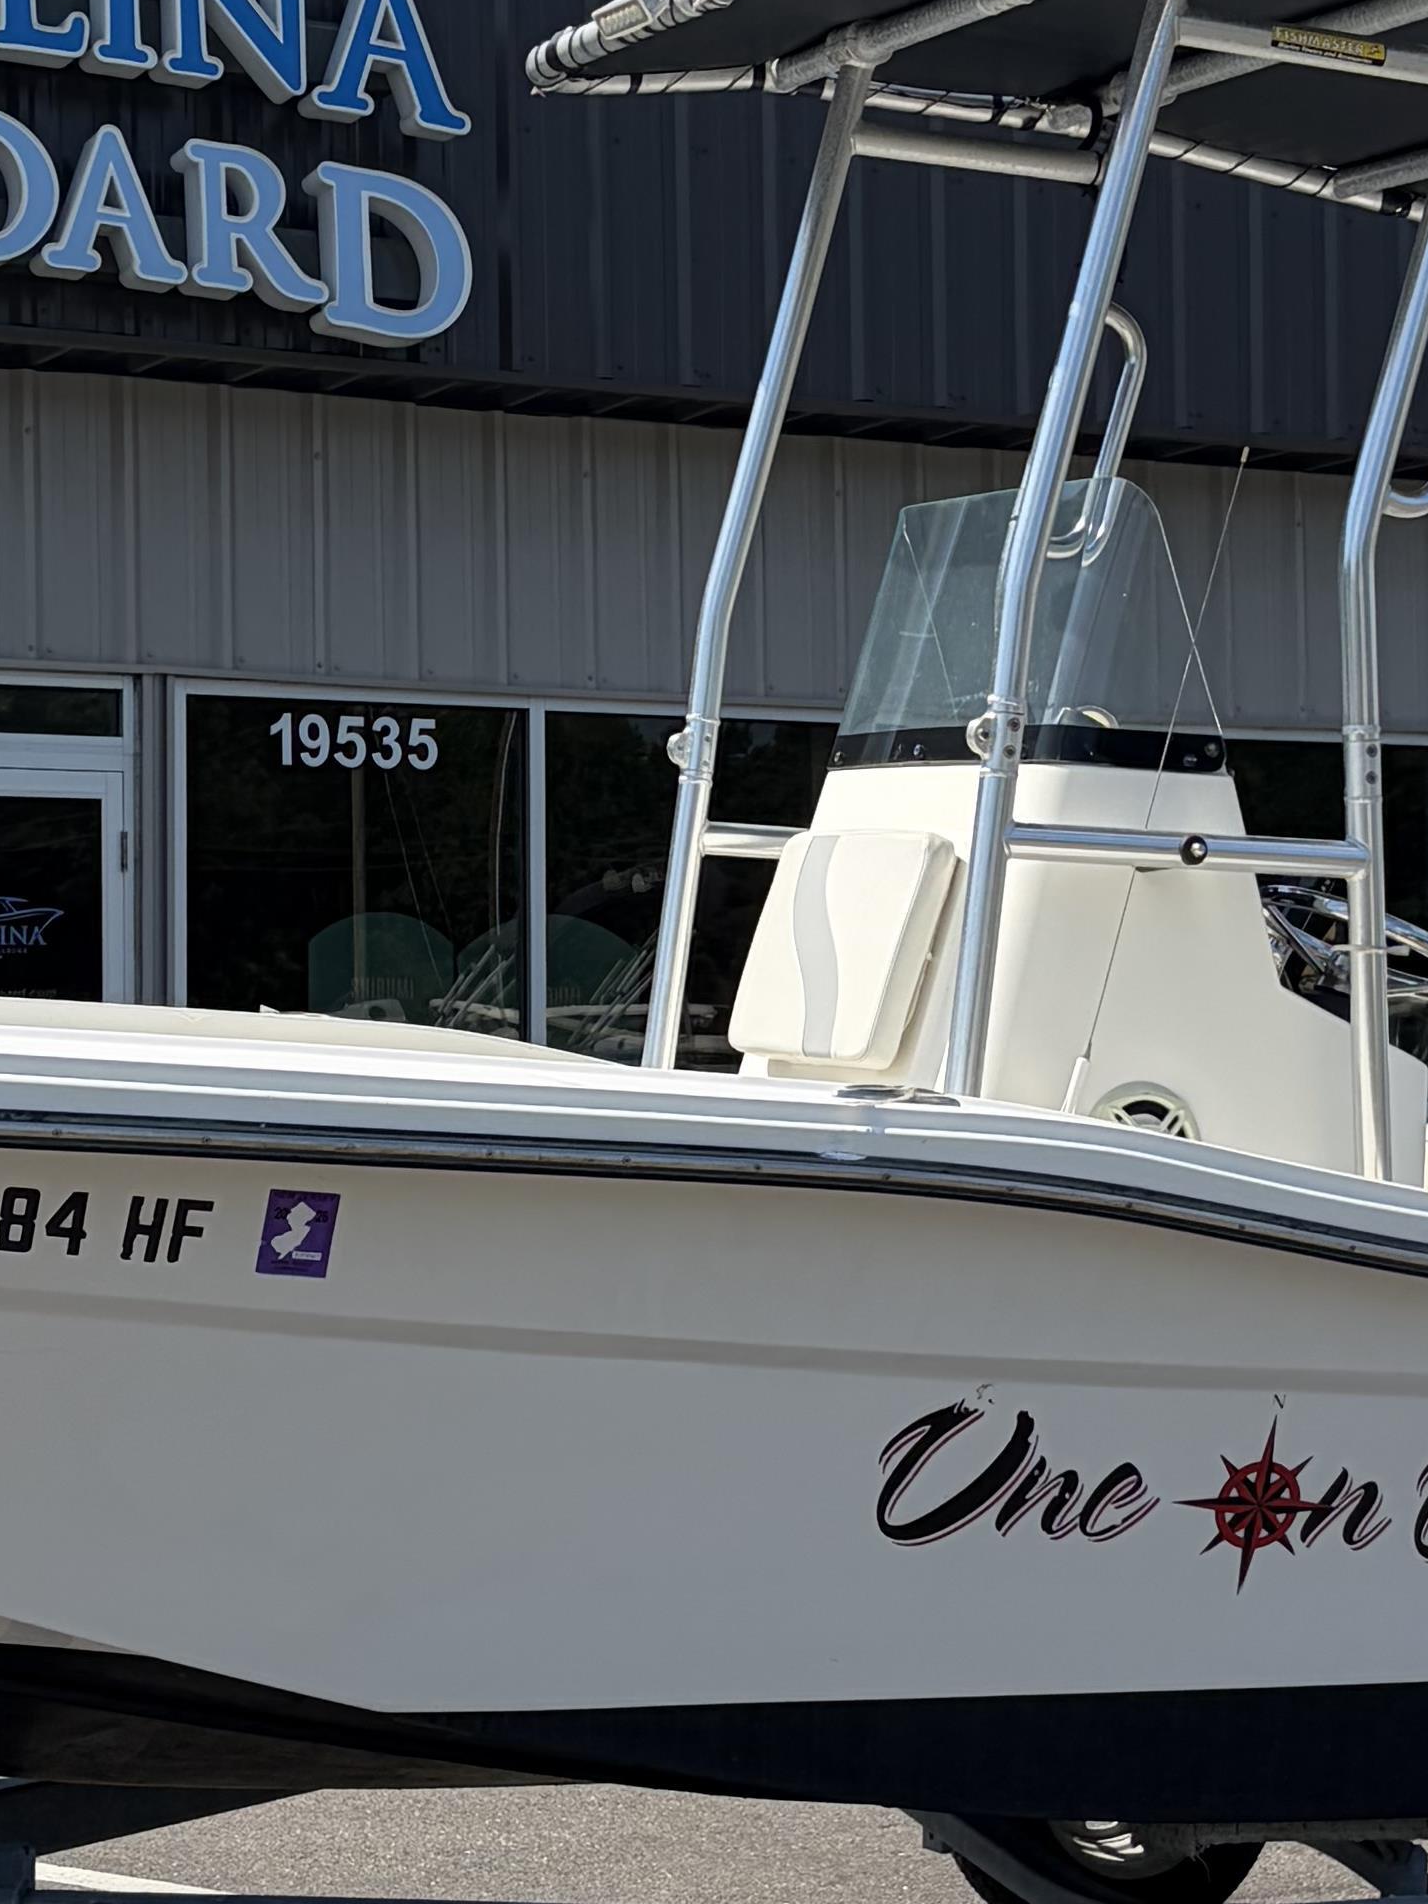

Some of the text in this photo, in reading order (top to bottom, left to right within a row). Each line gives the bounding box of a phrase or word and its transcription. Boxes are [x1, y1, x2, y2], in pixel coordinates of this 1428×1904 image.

[1275, 27, 1364, 56] FISHMASTER
[269, 712, 439, 771] 19535
[119, 1195, 215, 1264] HF
[876, 1384, 1161, 1547] One
